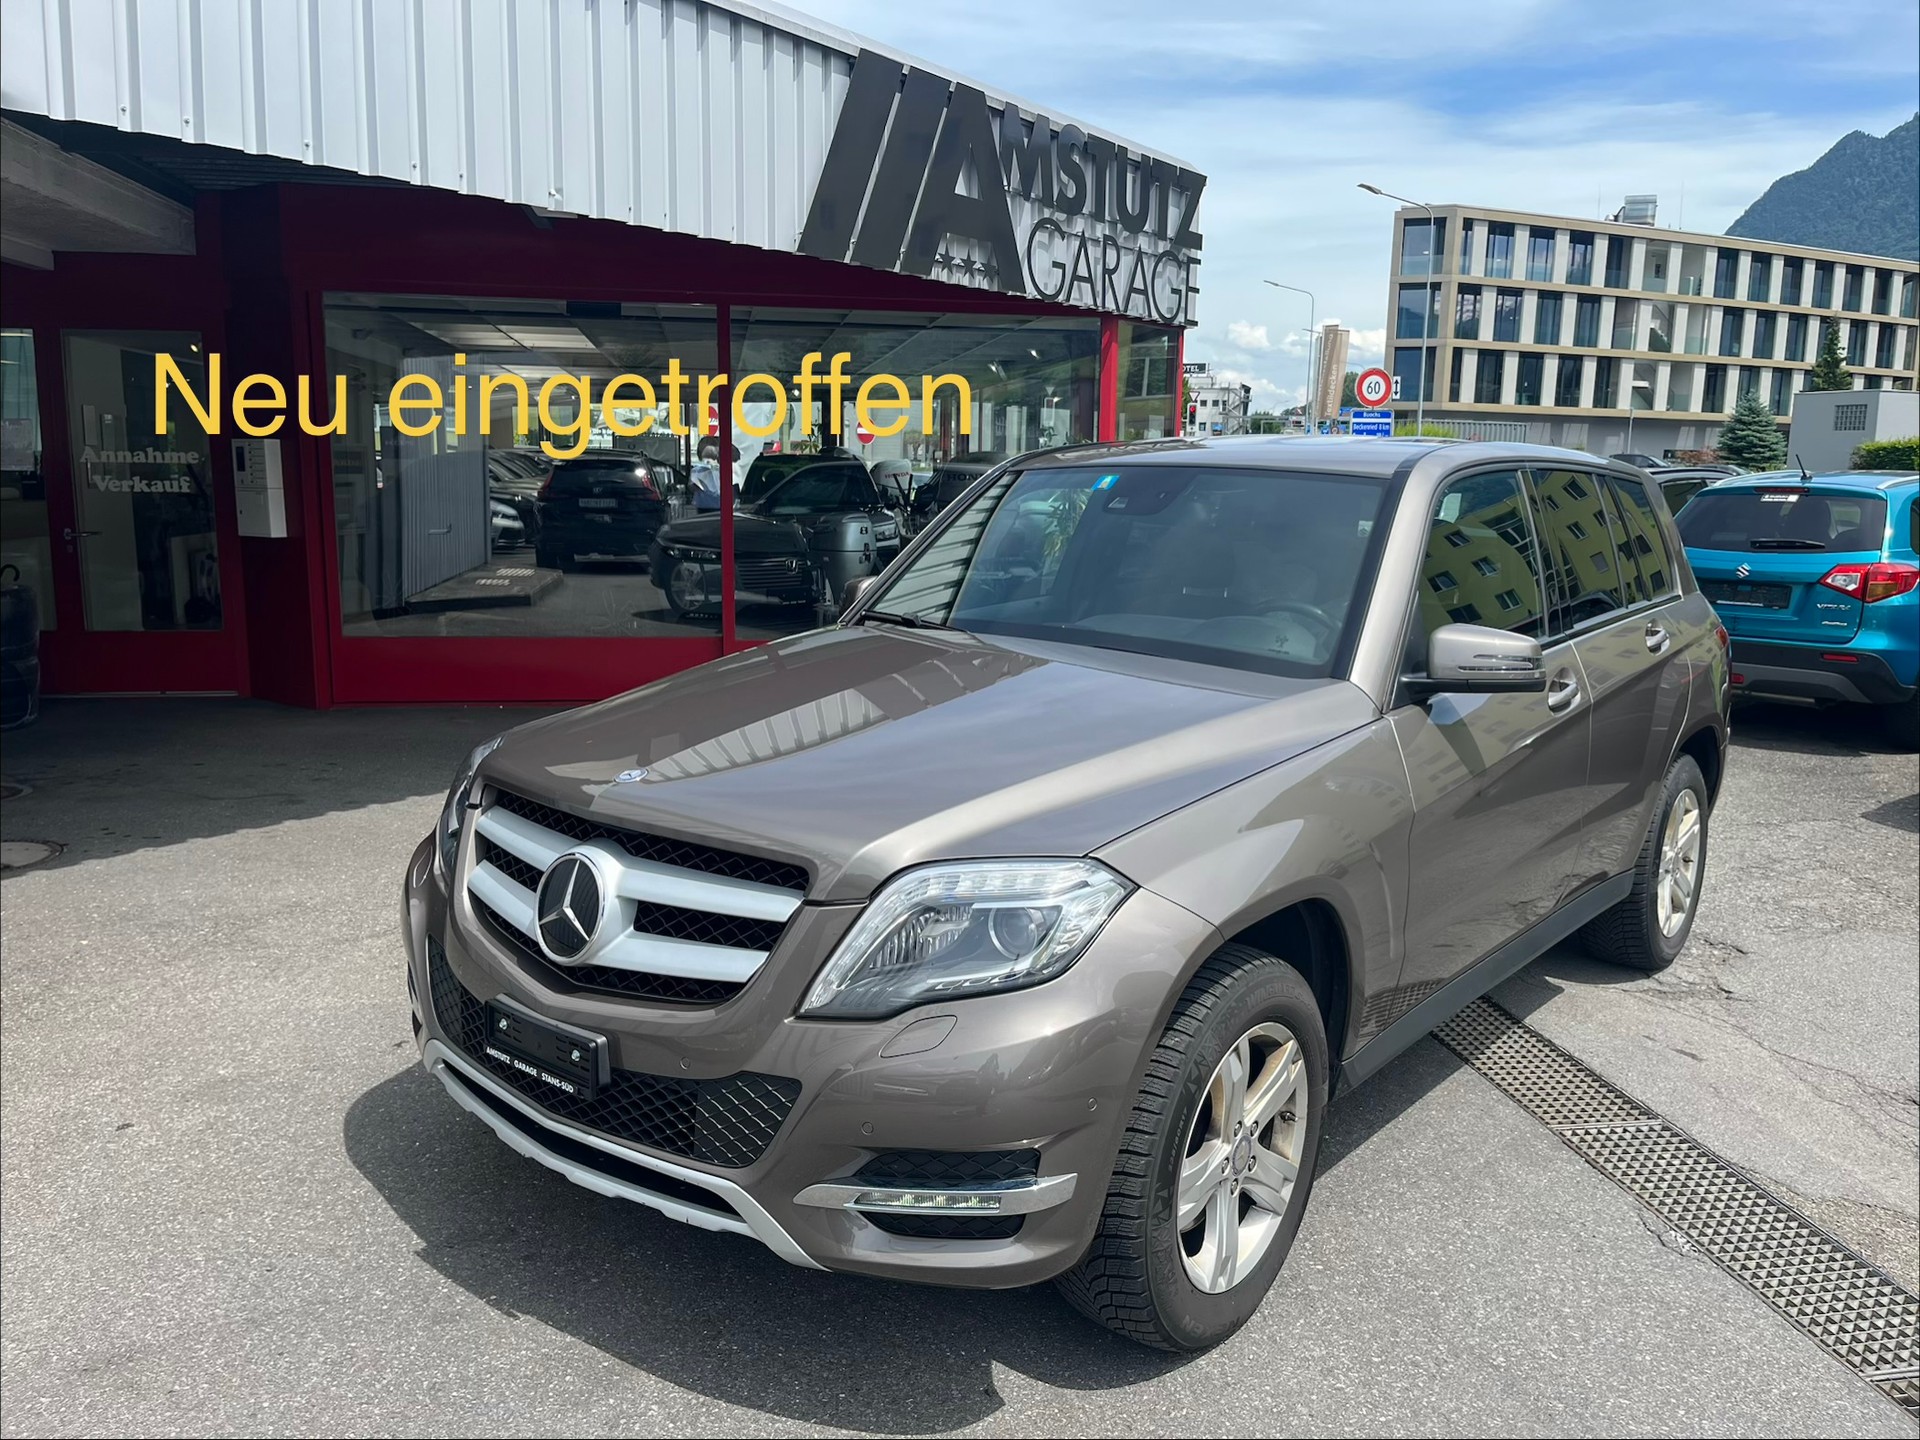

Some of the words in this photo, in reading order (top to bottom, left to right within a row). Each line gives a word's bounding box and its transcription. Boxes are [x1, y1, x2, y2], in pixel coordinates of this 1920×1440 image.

[1026, 217, 1201, 327] GARAGE
[1366, 381, 1381, 395] 60
[1353, 423, 1378, 431] Beckenried
[1383, 423, 1390, 431] km
[79, 445, 200, 464] Annahme
[92, 475, 191, 493] Verkauf
[946, 473, 984, 481] HON
[486, 1046, 511, 1064] AMSTUTZ
[513, 1059, 538, 1077] GARAGE
[541, 1072, 574, 1093] STANS-SÜD
